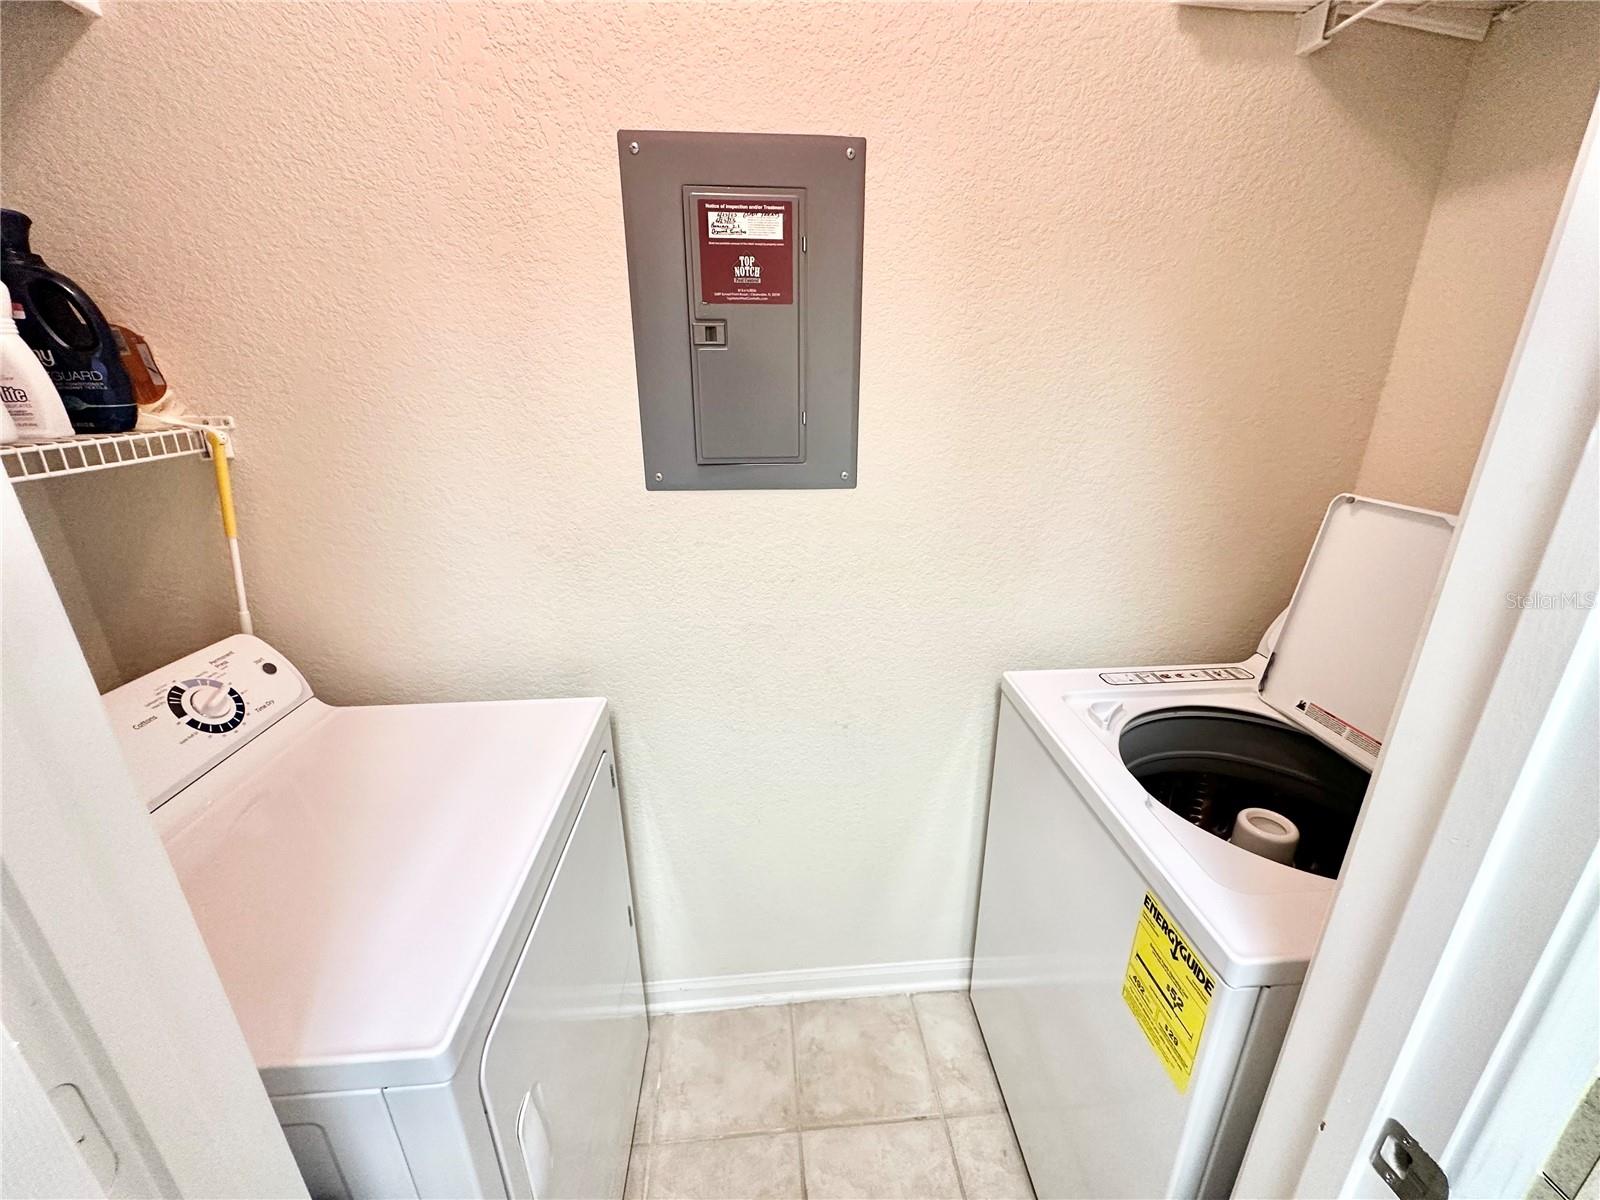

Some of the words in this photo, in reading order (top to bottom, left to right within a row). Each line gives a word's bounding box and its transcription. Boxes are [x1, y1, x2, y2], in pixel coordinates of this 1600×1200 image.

[739, 256, 755, 267] TOP
[734, 266, 760, 277] NOTCH
[49, 370, 104, 381] GUARD
[254, 704, 266, 713] Time
[265, 699, 275, 708] Dry
[132, 715, 158, 730] Cottons
[1143, 894, 1215, 997] ENERGYGUIDE
[1166, 983, 1184, 1012] $52
